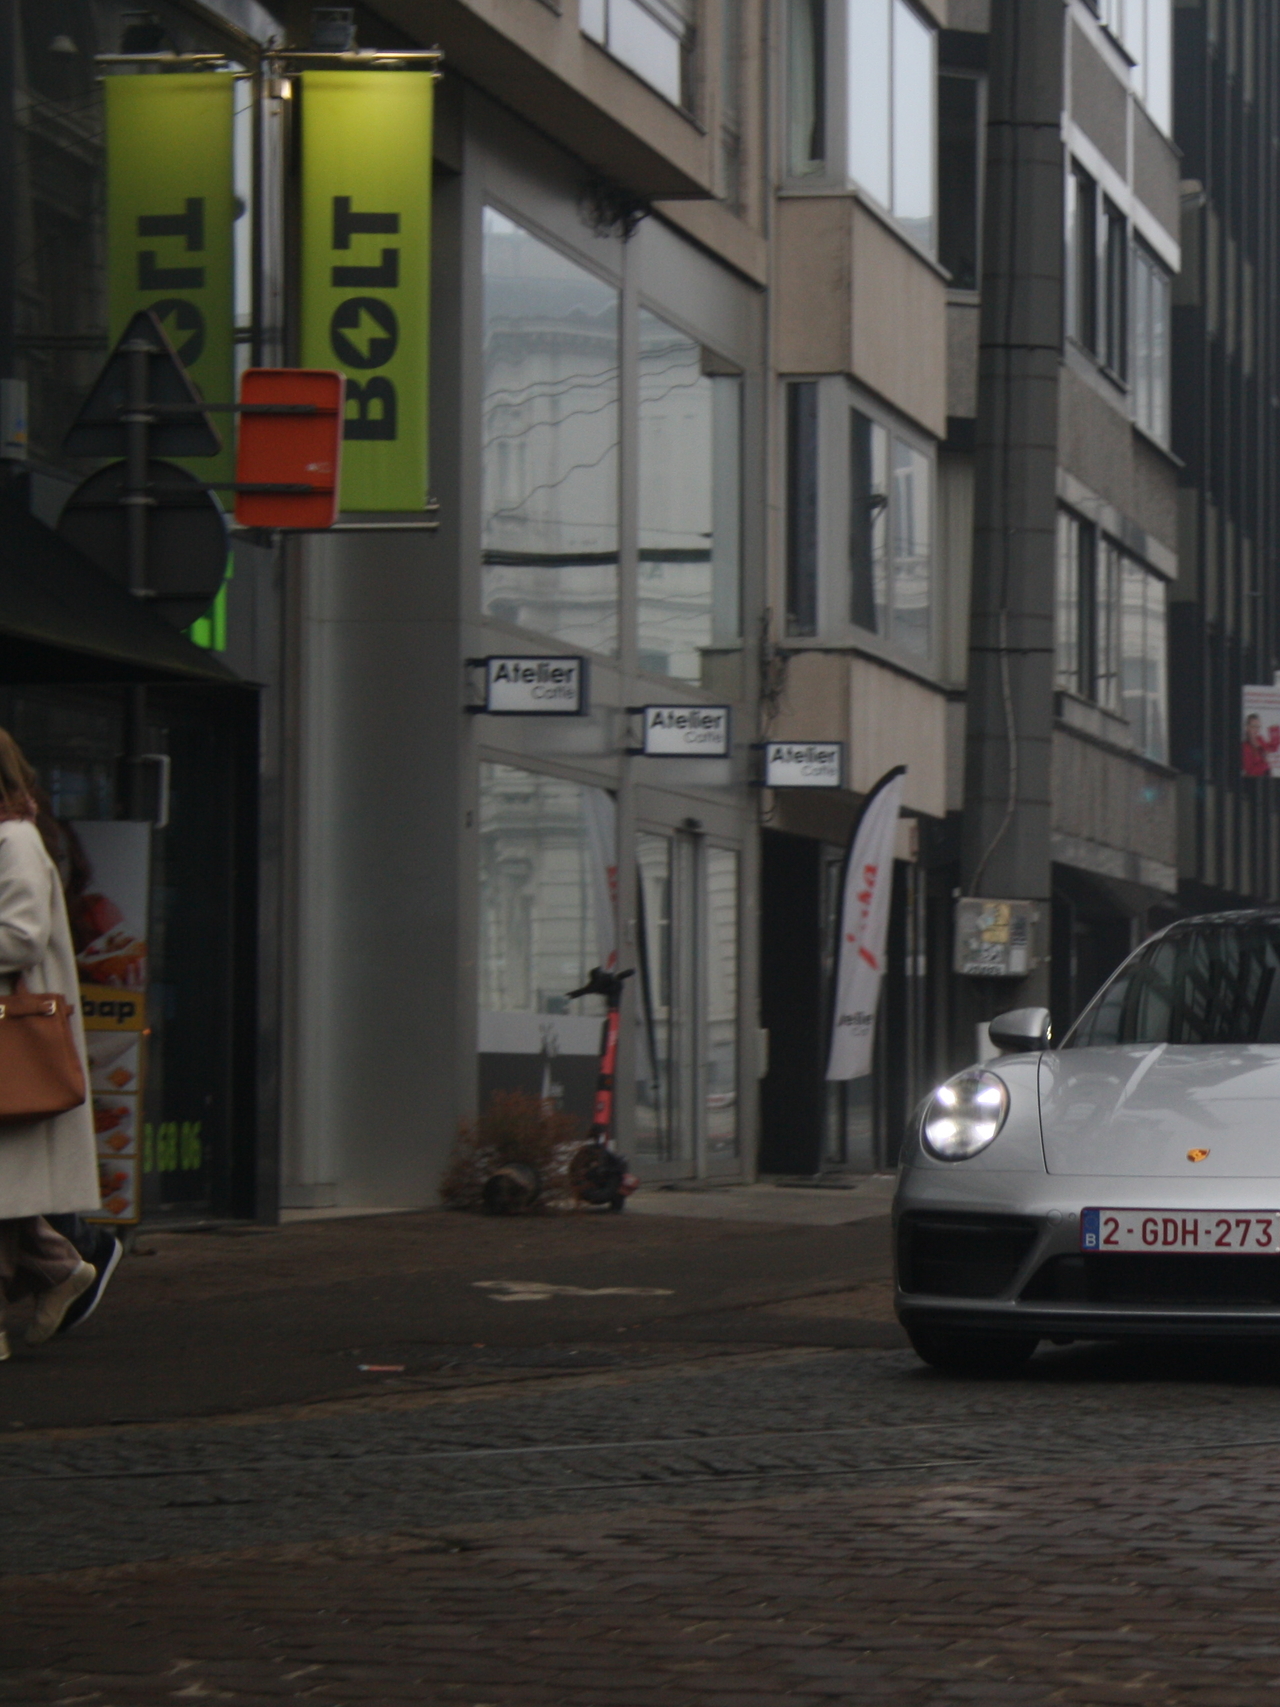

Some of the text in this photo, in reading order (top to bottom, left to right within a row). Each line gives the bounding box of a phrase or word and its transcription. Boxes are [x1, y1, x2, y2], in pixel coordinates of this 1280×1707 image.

[331, 195, 400, 441] BOLT
[493, 663, 575, 683] Atelier
[650, 711, 723, 729] Atelier
[771, 747, 835, 763] Atelier
[1085, 1233, 1096, 1247] B
[1103, 1217, 1273, 1247] 2-GDH-273
